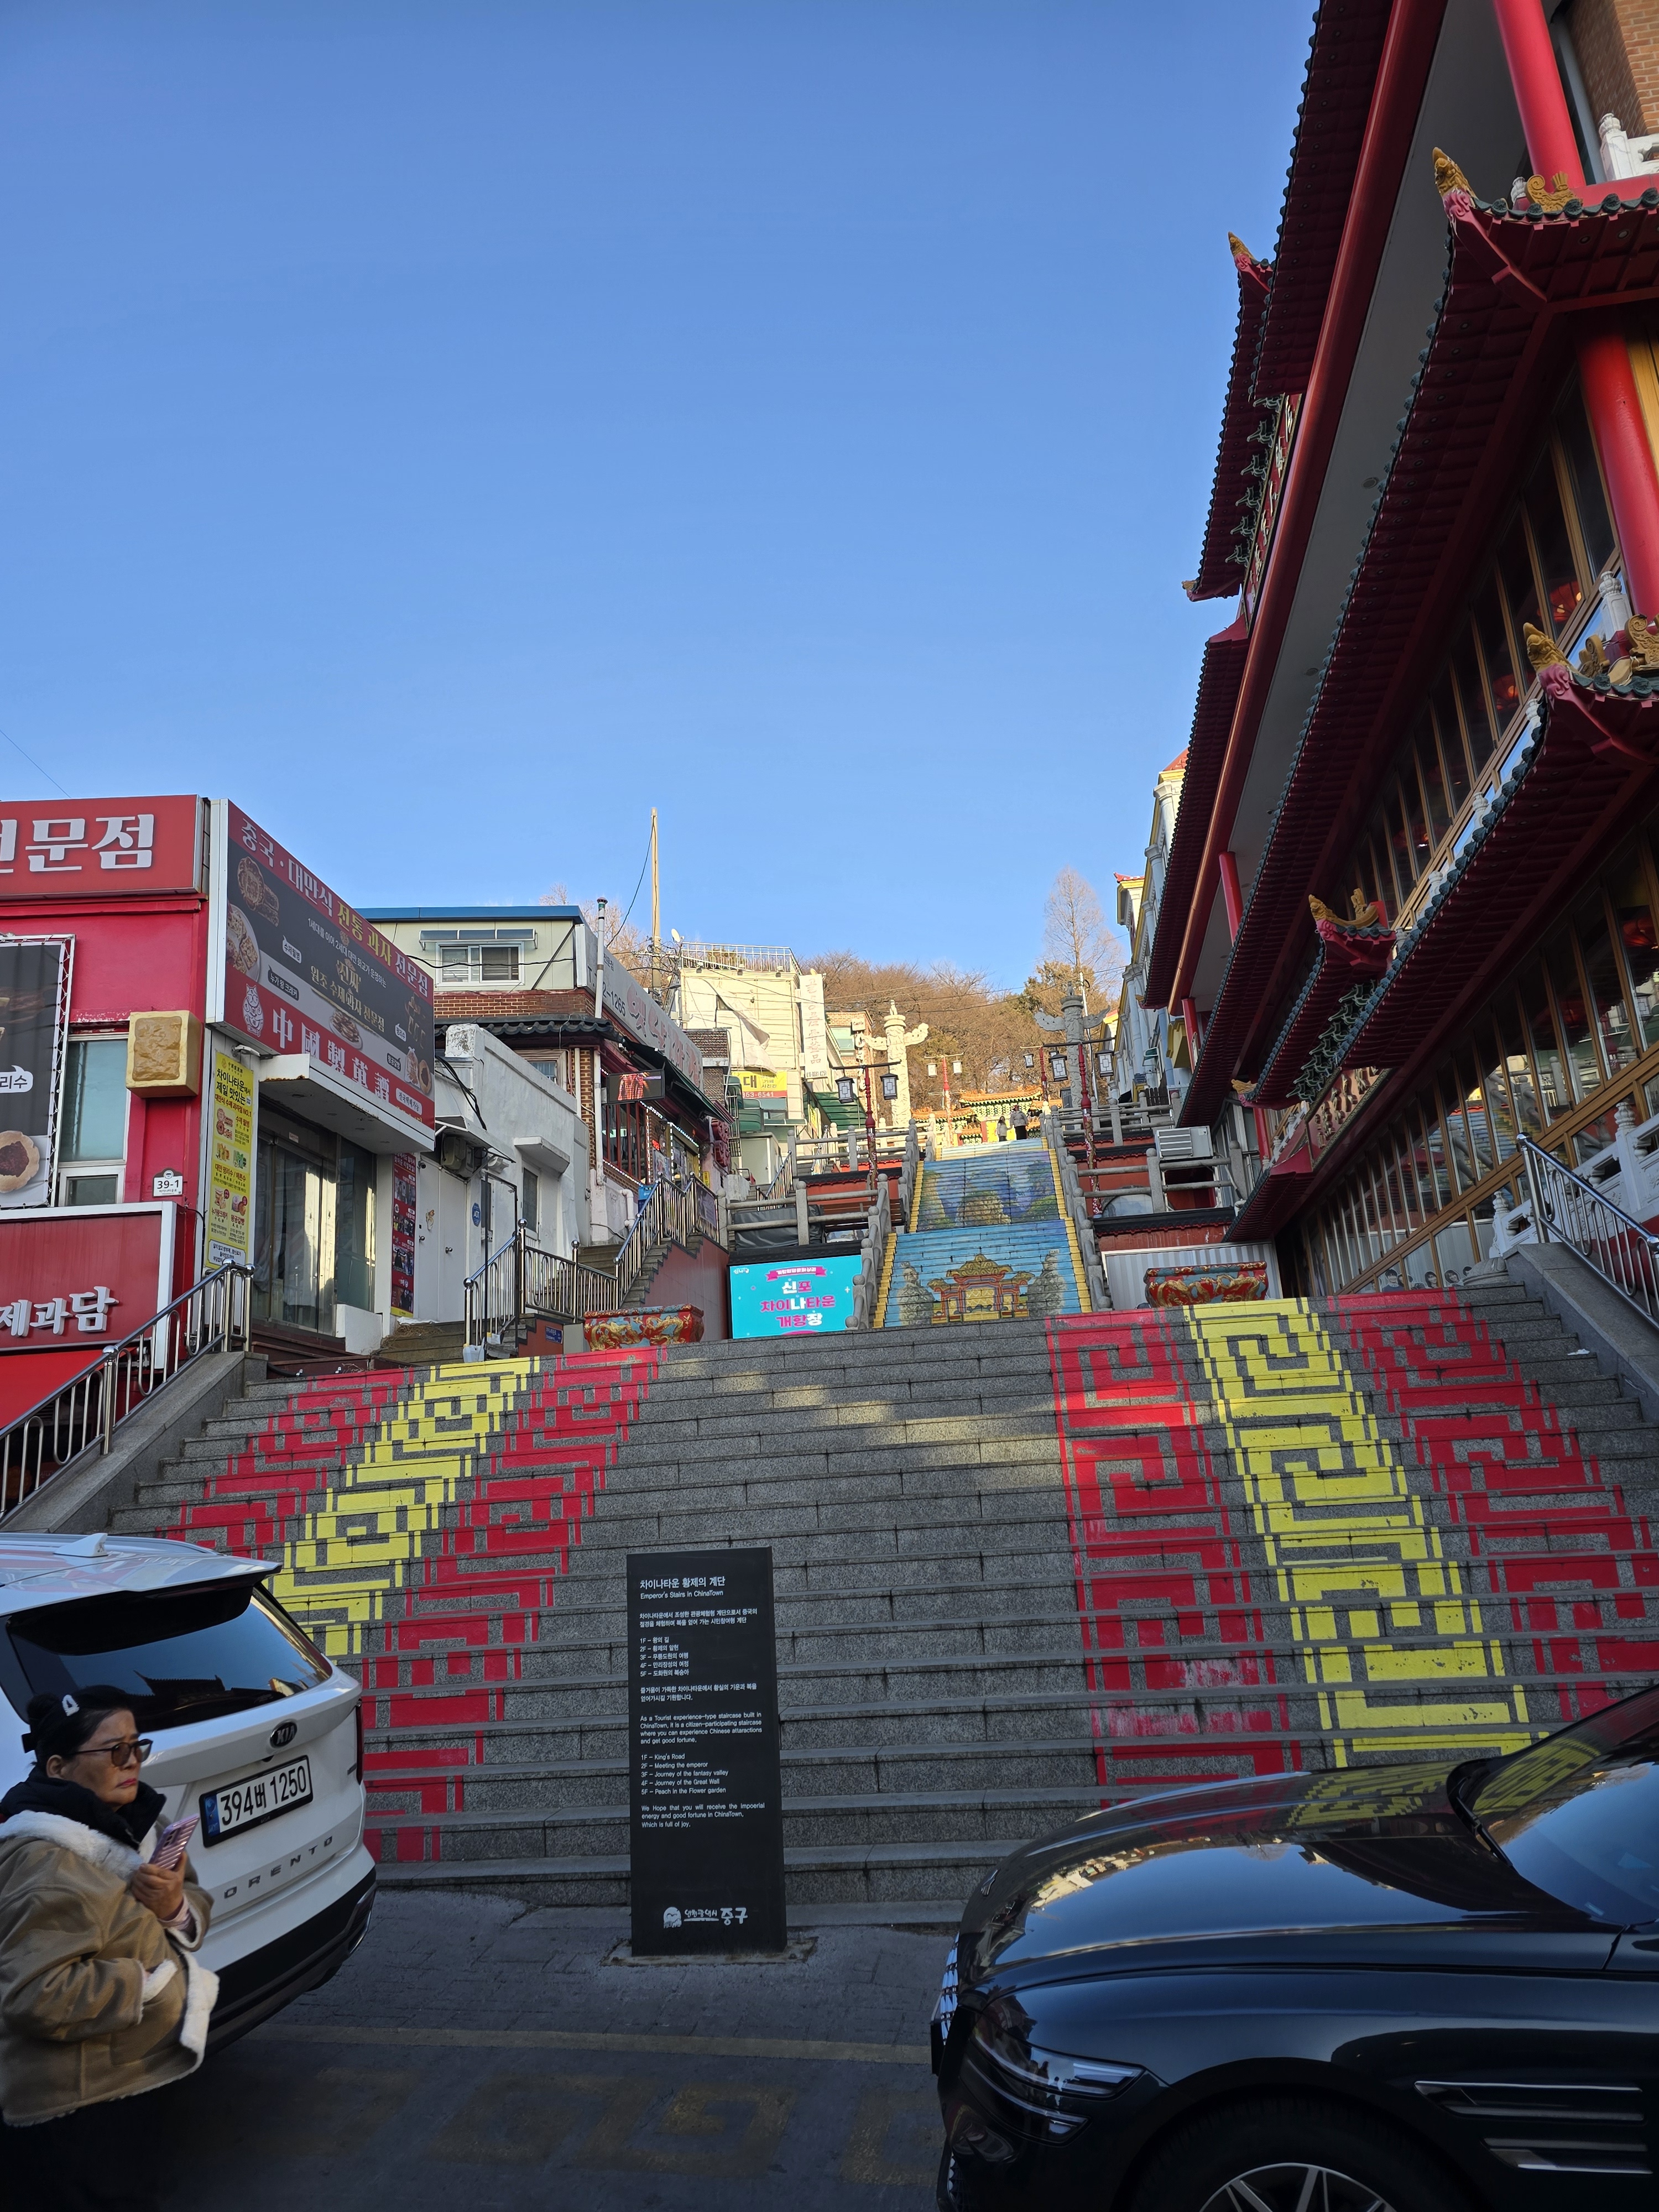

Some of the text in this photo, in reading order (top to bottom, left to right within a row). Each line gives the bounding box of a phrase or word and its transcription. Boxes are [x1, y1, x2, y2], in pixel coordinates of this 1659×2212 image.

[337, 901, 364, 941] 전통
[367, 927, 392, 967] 과자
[395, 951, 427, 998] 전문점
[371, 968, 387, 988] 운영하는
[311, 966, 327, 989] 원조
[363, 1005, 384, 1032] 전문점
[216, 1081, 228, 1097] 제일
[229, 1087, 246, 1106] 맛있는
[157, 1180, 179, 1189] 39-1
[782, 1280, 812, 1294] 신포
[760, 1295, 836, 1312] 차이나타운
[776, 1312, 823, 1327] 개항장
[640, 1591, 668, 1600] Emperor's
[276, 1725, 296, 1745] KIA
[270, 1765, 307, 1804] 1250
[224, 1835, 333, 1899] ORENTO
[720, 1907, 748, 1926] 중구
